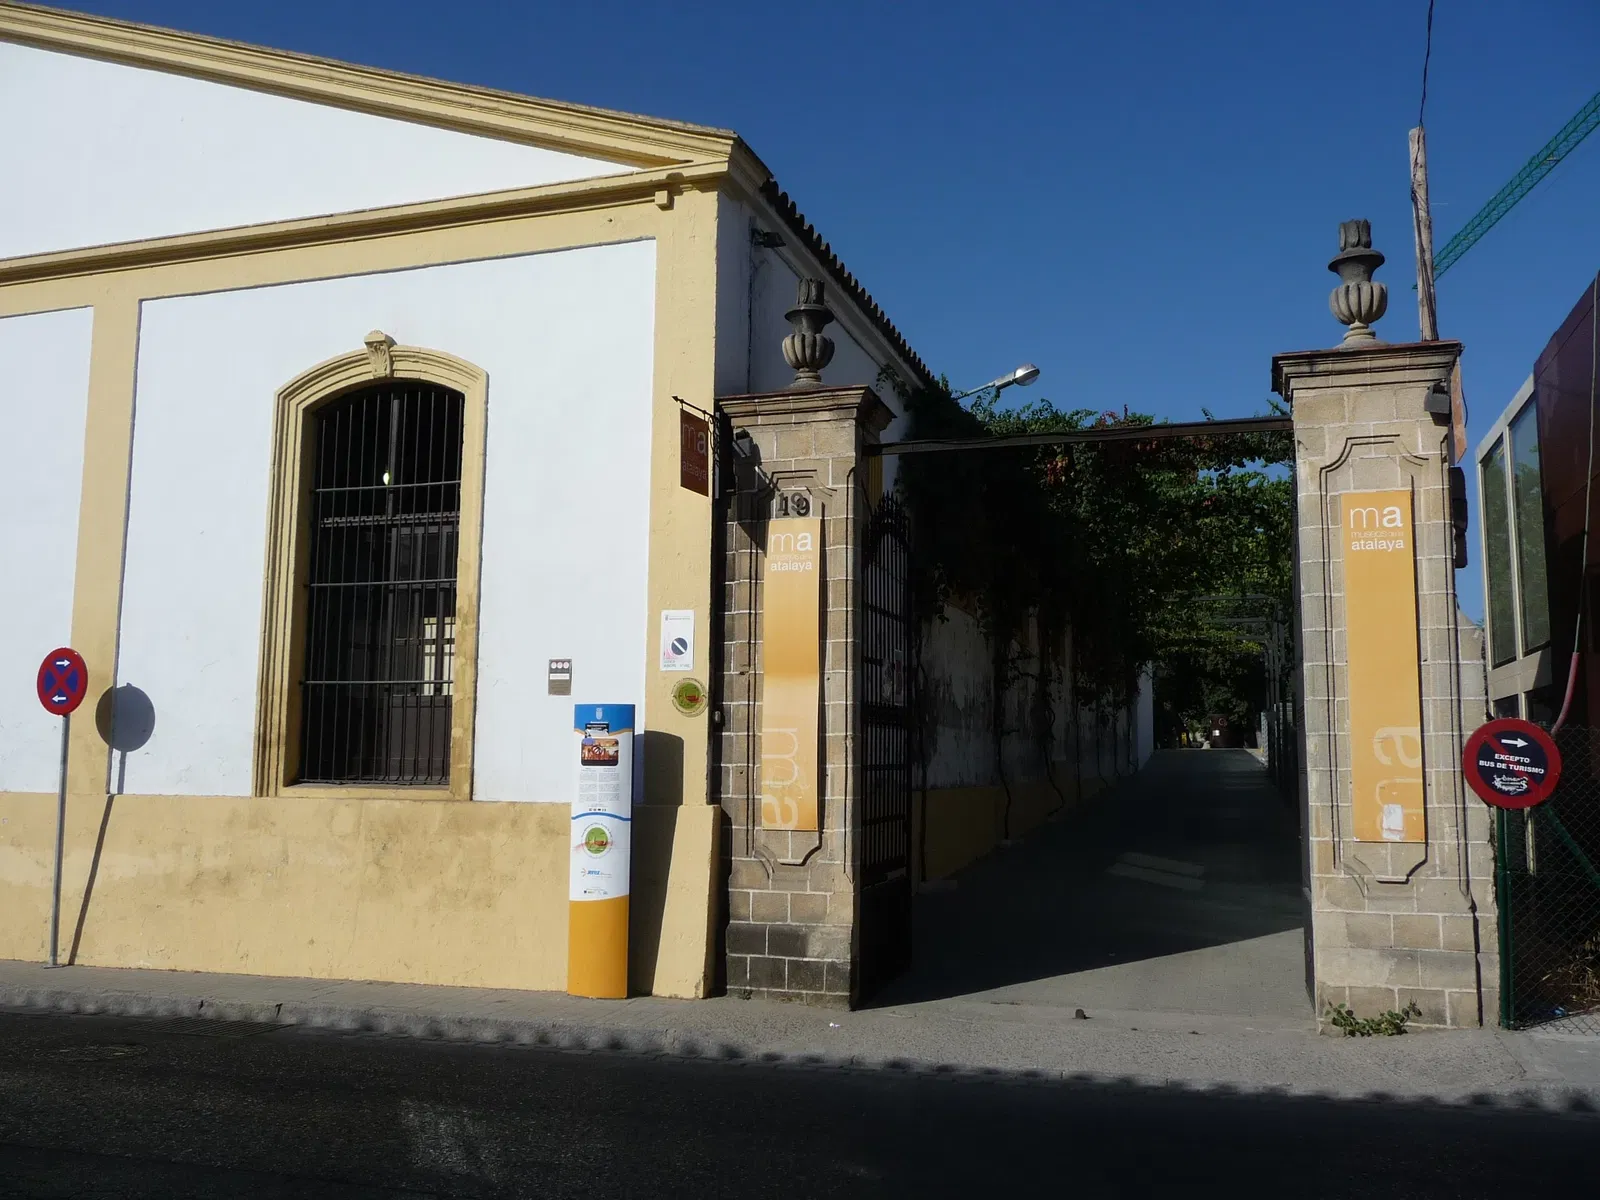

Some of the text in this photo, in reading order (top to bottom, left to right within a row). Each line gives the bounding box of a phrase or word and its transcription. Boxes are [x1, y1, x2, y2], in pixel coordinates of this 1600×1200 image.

[682, 423, 707, 456] ma
[778, 491, 806, 513] 19
[1350, 506, 1404, 529] ma
[771, 532, 813, 552] ma
[1351, 538, 1404, 553] atalaya
[771, 561, 812, 573] atalaya
[1478, 759, 1545, 775] BUS DE TURISMO
[1494, 753, 1531, 764] EXCEPTO
